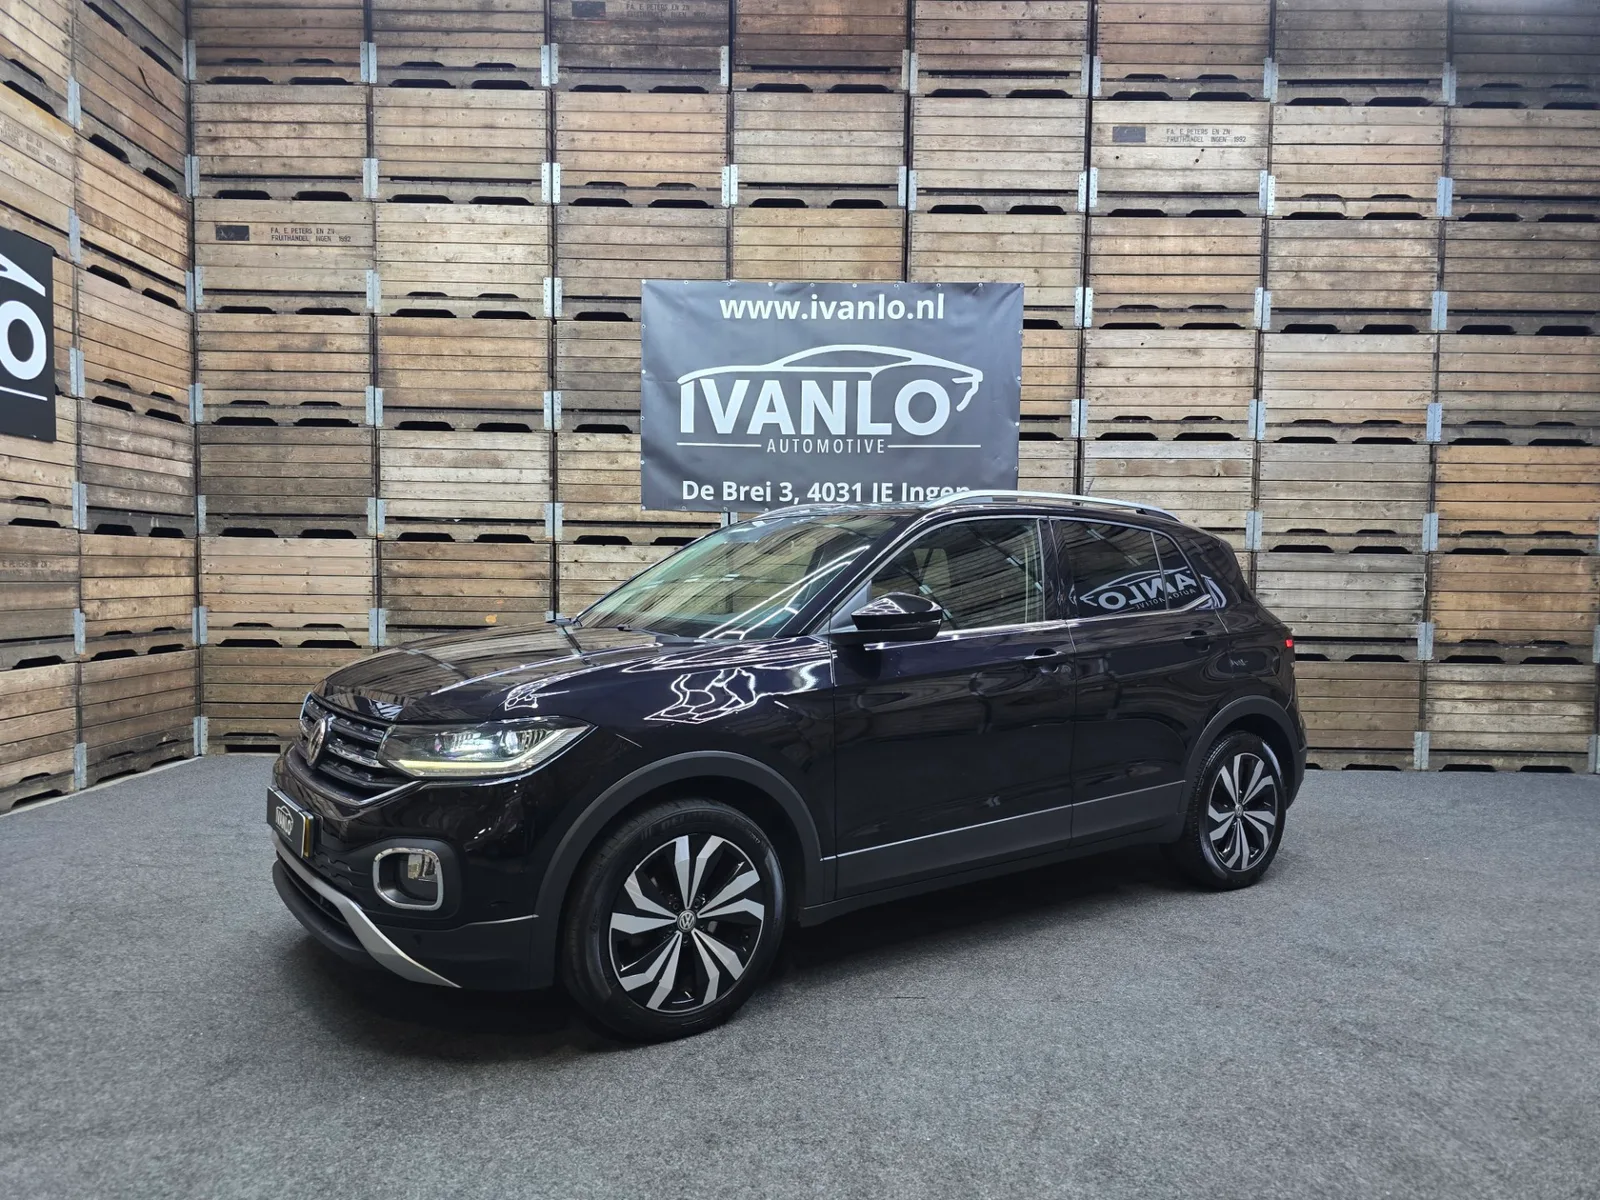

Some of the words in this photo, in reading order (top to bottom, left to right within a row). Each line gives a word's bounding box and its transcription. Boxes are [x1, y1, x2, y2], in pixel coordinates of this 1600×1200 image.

[290, 227, 313, 235] PETERS
[720, 293, 945, 320] www.ivanlo.nl
[680, 378, 951, 436] IVANLO
[766, 438, 886, 454] AUTOMOTIVE
[682, 480, 715, 501] De
[722, 480, 772, 502] Brei
[779, 481, 800, 505] 3,
[806, 482, 863, 503] 4031
